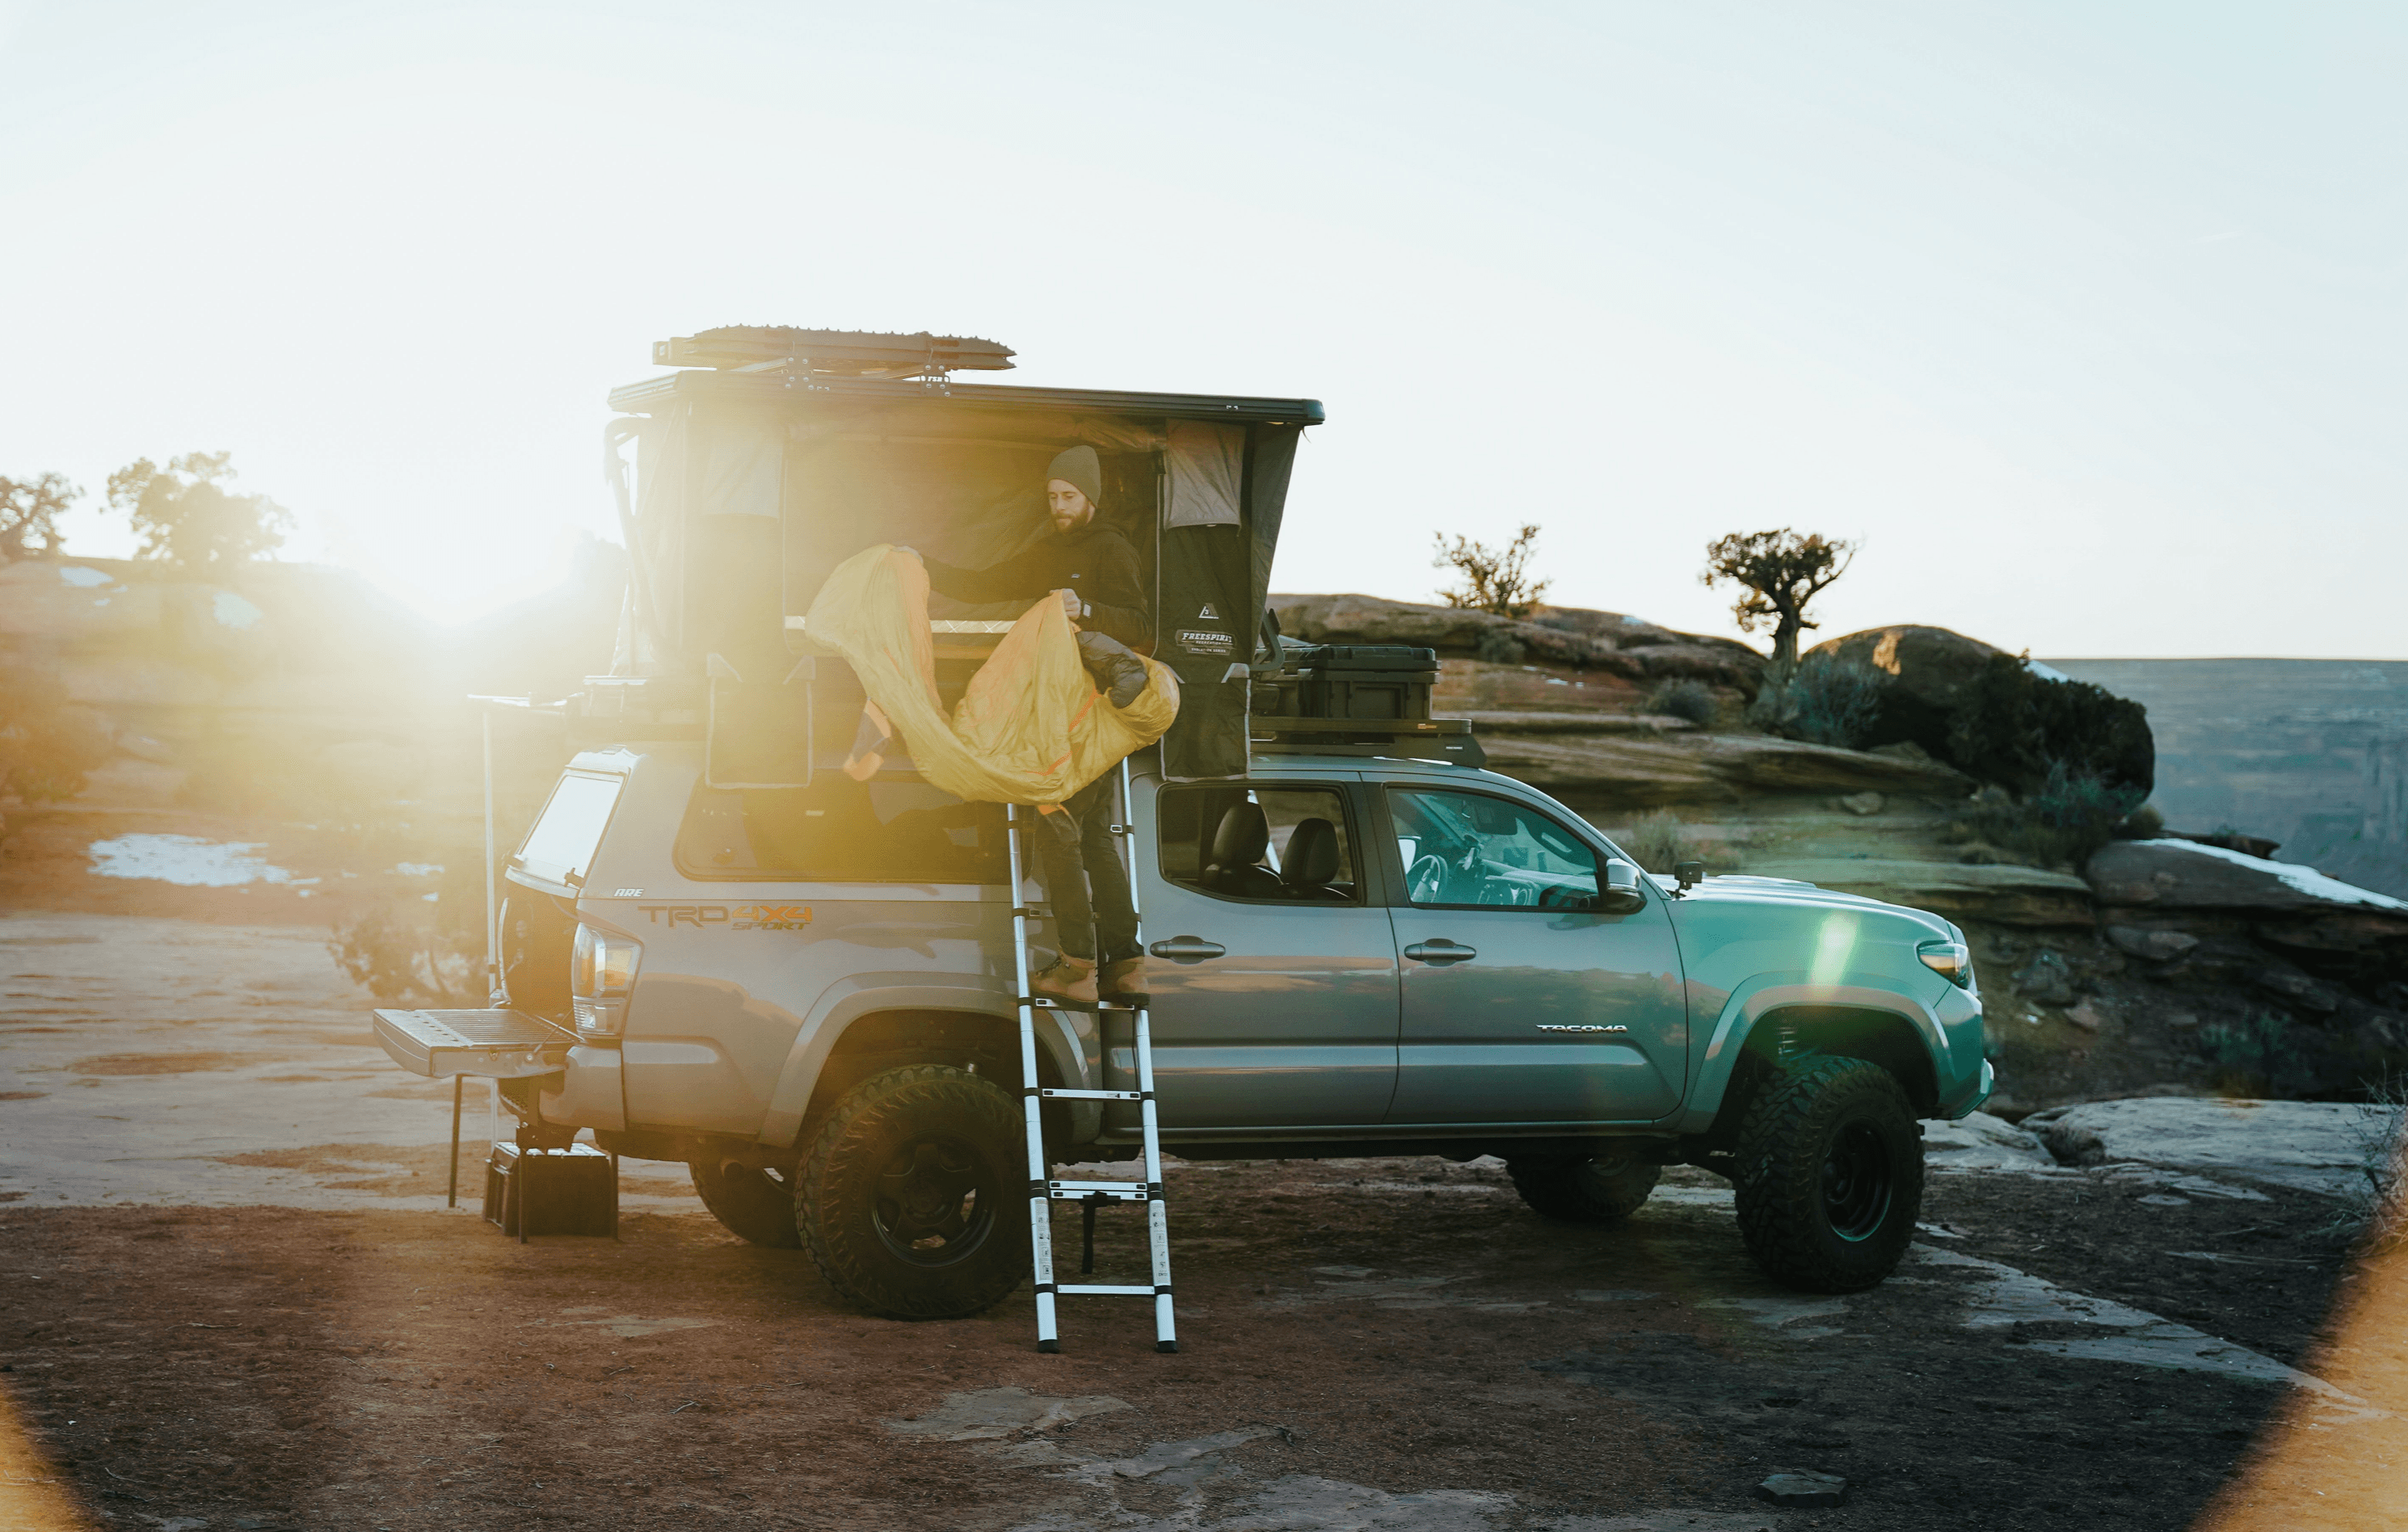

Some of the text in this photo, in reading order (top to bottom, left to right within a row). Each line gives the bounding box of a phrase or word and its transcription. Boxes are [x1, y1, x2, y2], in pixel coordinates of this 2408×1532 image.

[1181, 633, 1232, 643] FREESPIRIT
[613, 888, 645, 897] ARE
[637, 906, 729, 928] TRD
[730, 922, 810, 930] SPORT
[1535, 1025, 1628, 1033] TACOMA
